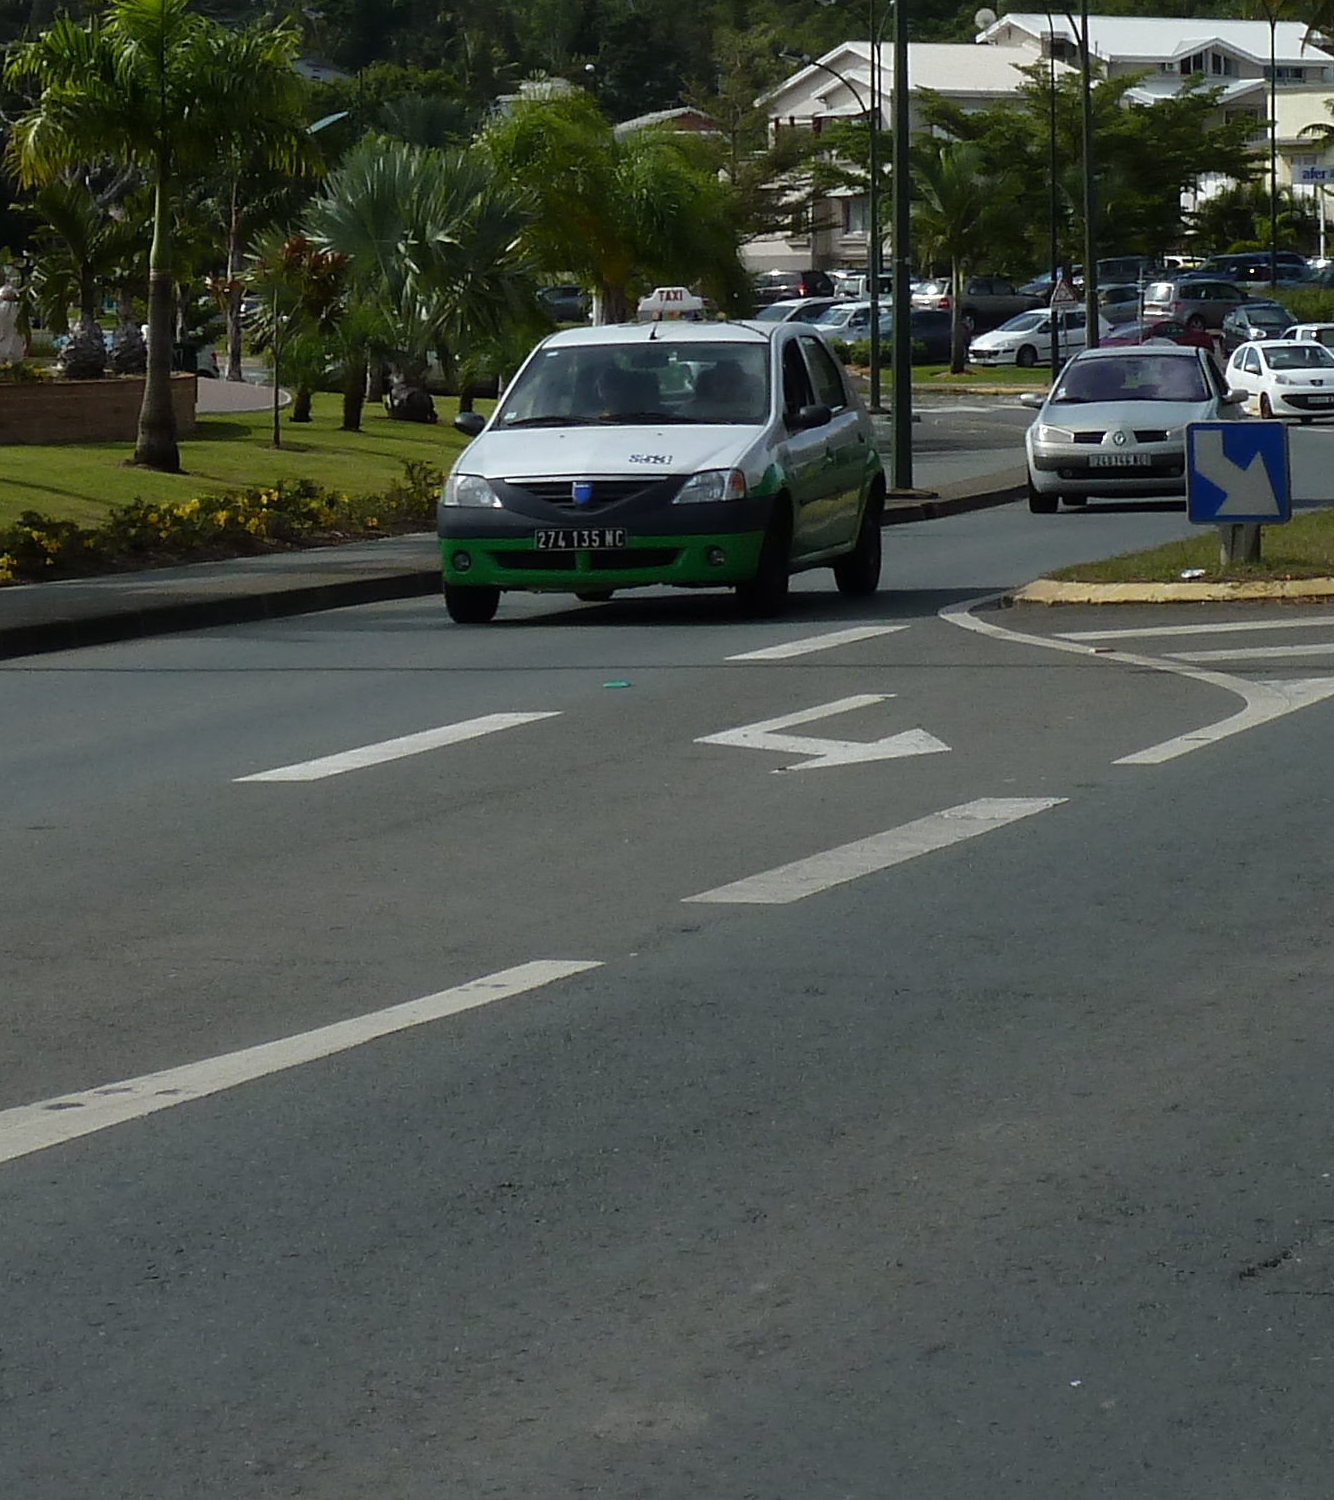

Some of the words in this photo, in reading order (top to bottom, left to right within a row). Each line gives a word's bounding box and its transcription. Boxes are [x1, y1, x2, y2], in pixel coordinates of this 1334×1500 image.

[1302, 166, 1327, 181] afer
[659, 289, 683, 302] TAXI
[538, 531, 566, 549] 274
[572, 531, 600, 549] 135
[605, 530, 623, 547] NC
